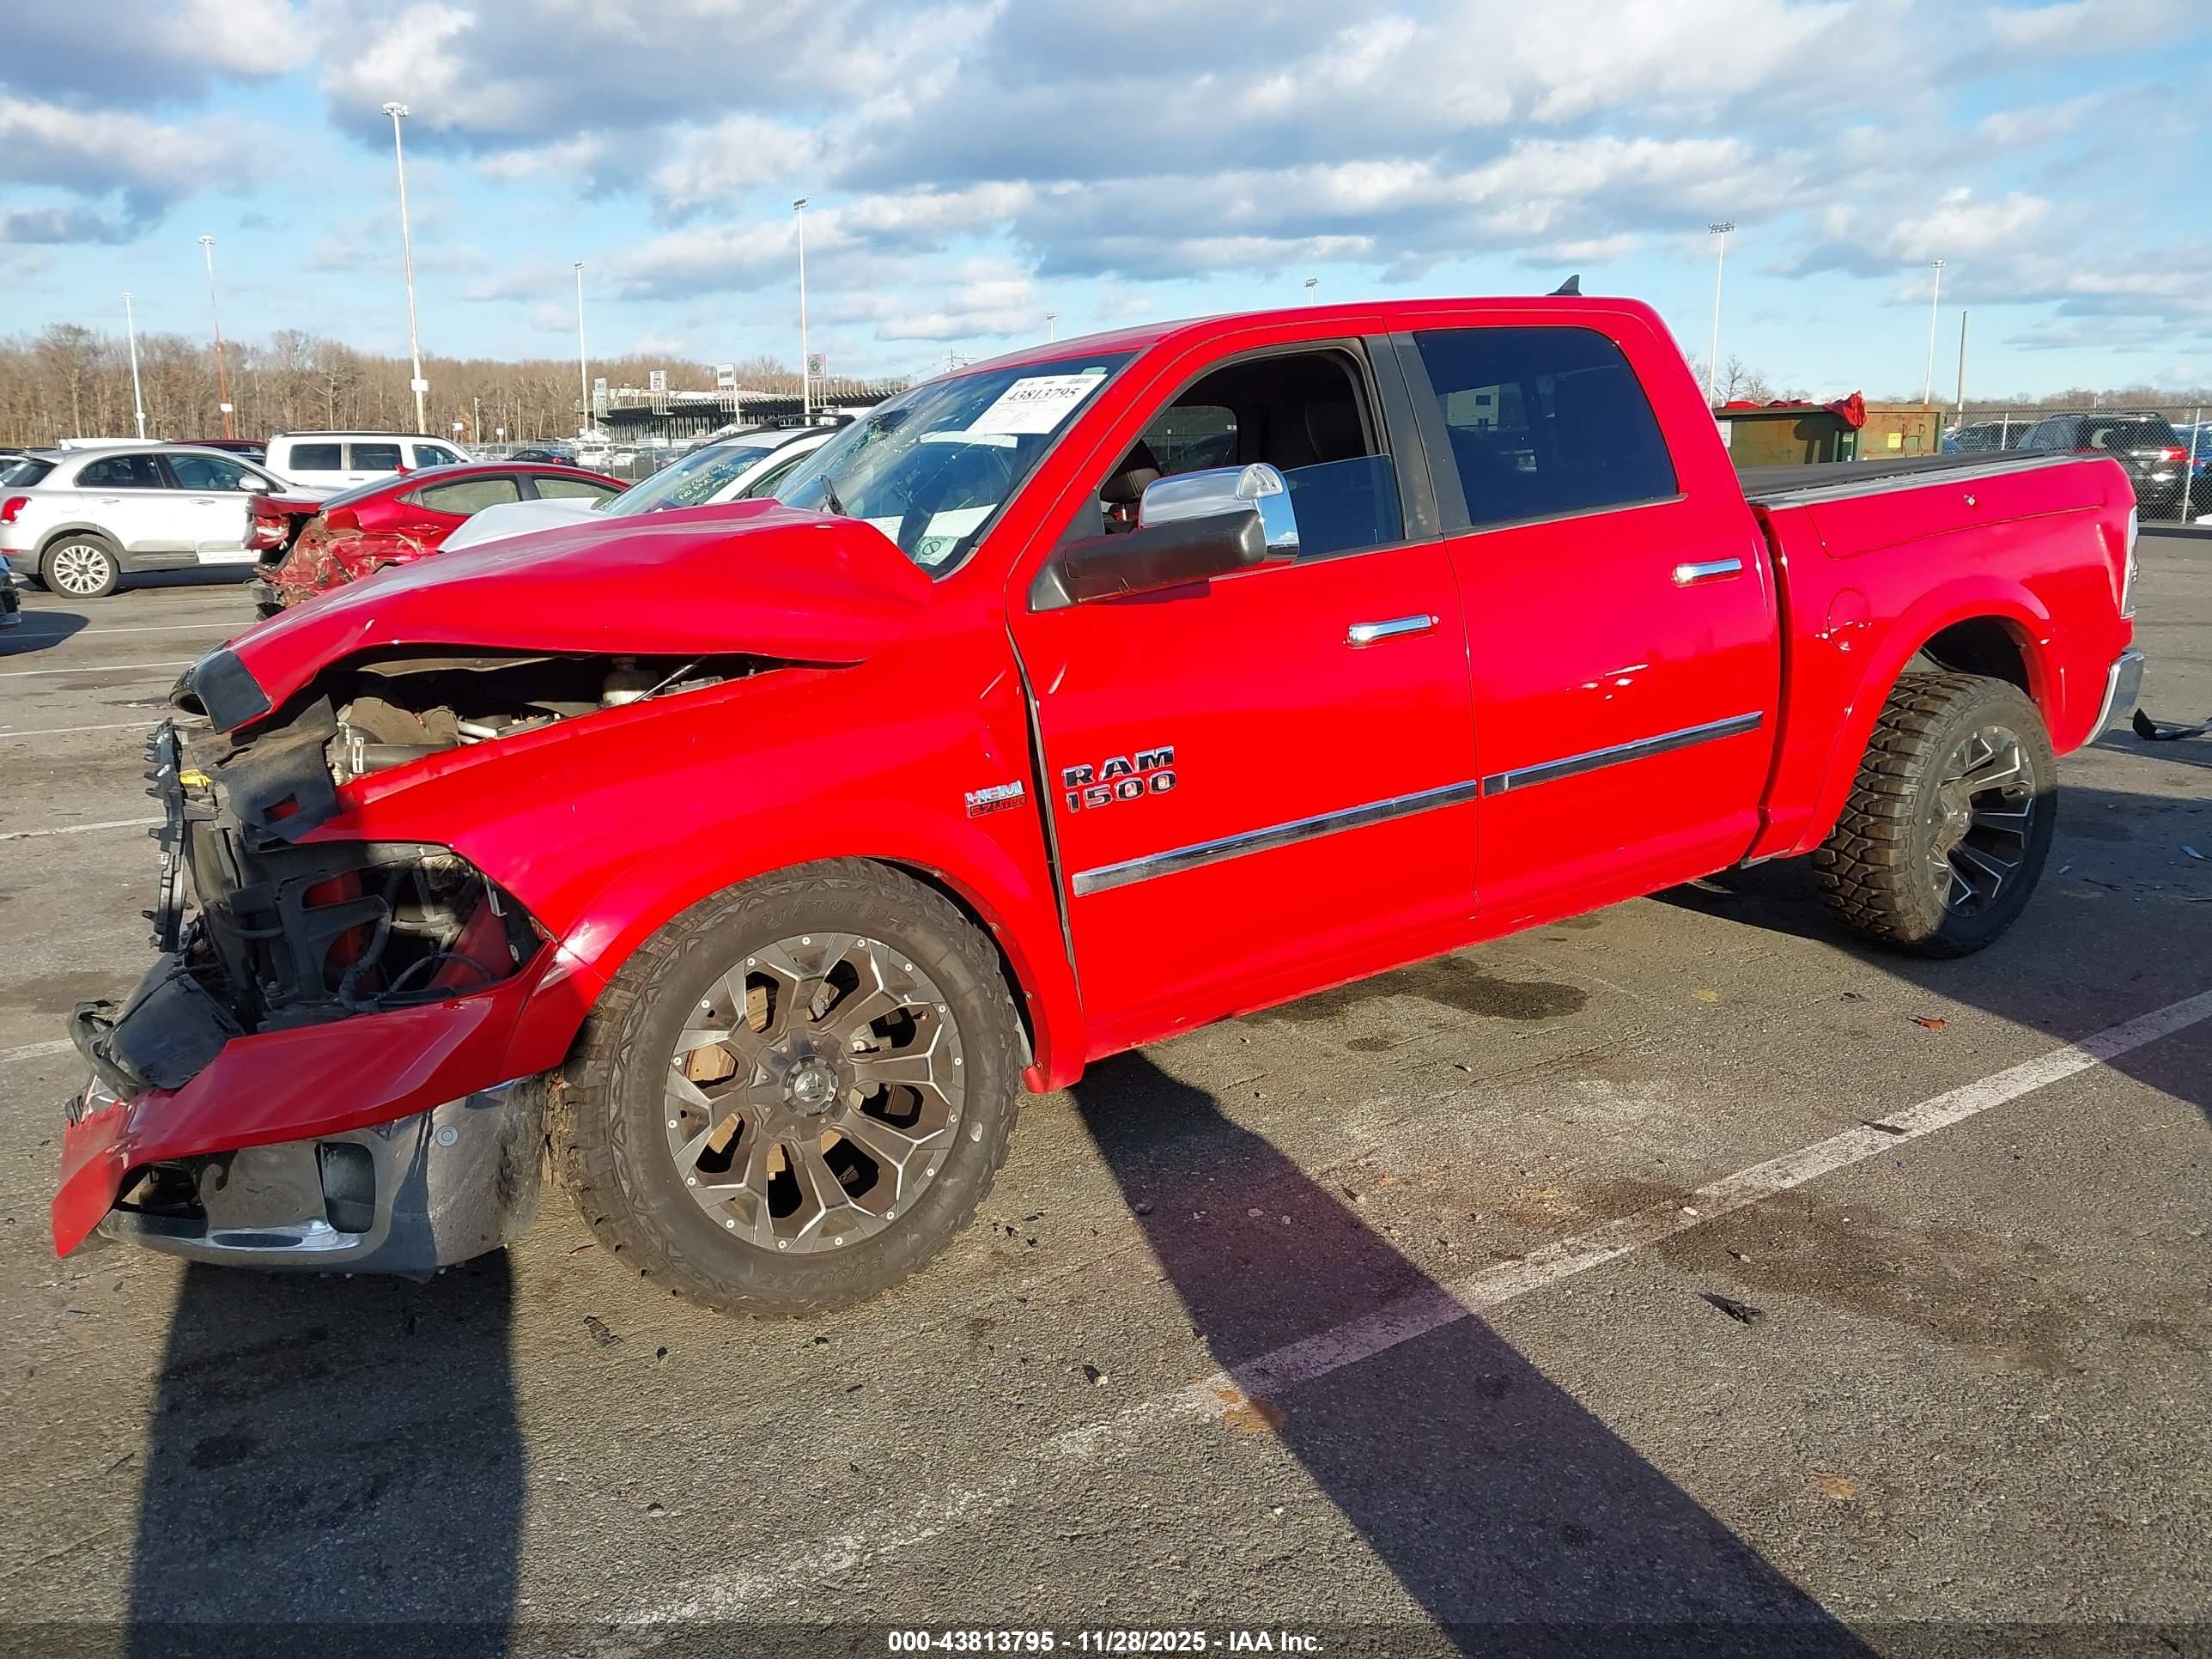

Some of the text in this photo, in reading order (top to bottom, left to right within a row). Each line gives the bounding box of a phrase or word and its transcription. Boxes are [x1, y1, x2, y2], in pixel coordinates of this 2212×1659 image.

[1006, 388, 1081, 402] 43813795
[1062, 745, 1175, 788] RAM
[1066, 770, 1177, 814] 1500
